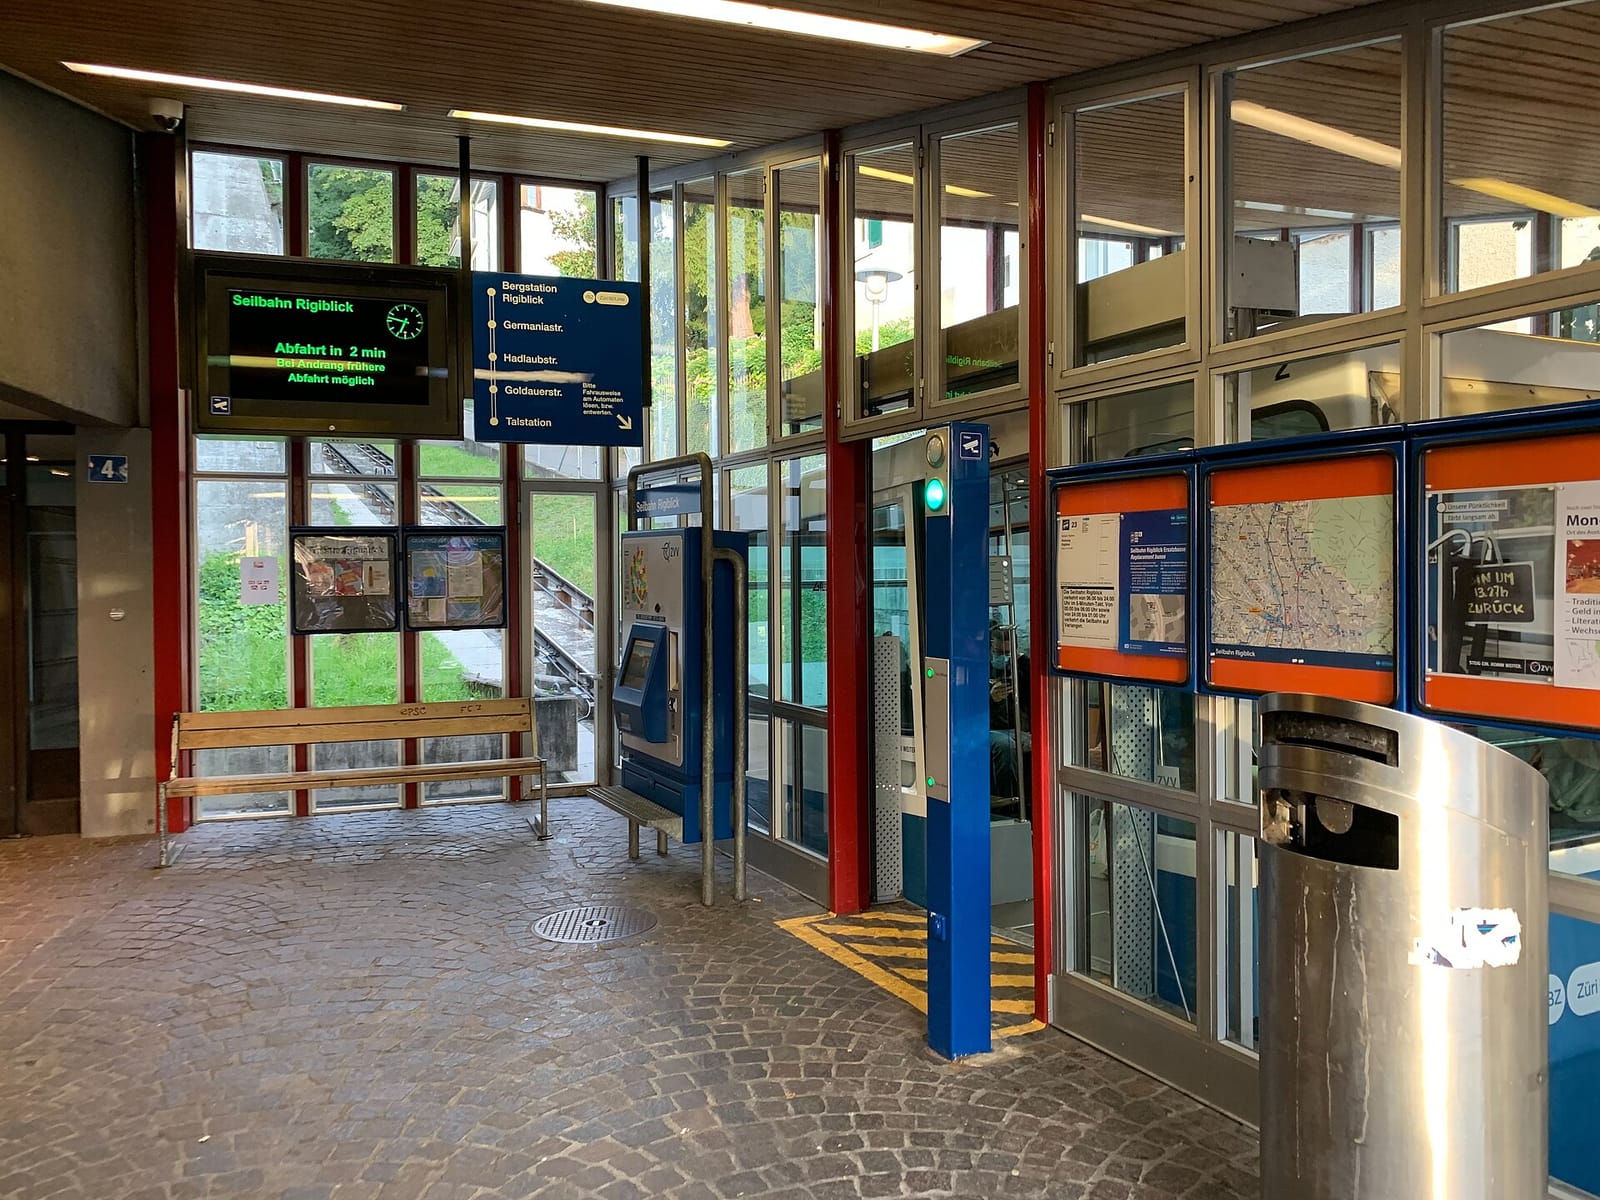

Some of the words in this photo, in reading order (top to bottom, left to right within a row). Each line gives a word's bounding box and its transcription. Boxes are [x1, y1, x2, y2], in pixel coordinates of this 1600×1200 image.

[502, 281, 558, 294] Bergstation
[232, 294, 292, 308] Seilbahn
[296, 298, 354, 312] Rigiblick
[502, 294, 544, 304] Rigiblick
[503, 320, 564, 332] Germaniastr.
[274, 342, 326, 356] Abfahrt
[330, 344, 342, 356] in
[350, 346, 358, 357] 2
[361, 347, 386, 358] min
[276, 358, 294, 368] Bei
[297, 359, 344, 371] Andrang
[347, 360, 386, 372] frühere
[503, 353, 558, 364] Hadlaubstr.
[288, 373, 329, 384] Abfahrt
[332, 375, 374, 386] möglich
[504, 386, 563, 397] Goldauerstr.
[505, 416, 552, 427] Talstation
[101, 460, 114, 478] 4
[636, 500, 656, 512] Seilbahn
[658, 496, 679, 512] Rigiblick
[1566, 514, 1600, 526] Mon
[671, 546, 679, 557] ZVV
[1495, 571, 1515, 586] UM
[1468, 600, 1524, 615] ZURÜCK
[1577, 979, 1598, 999] Züri
